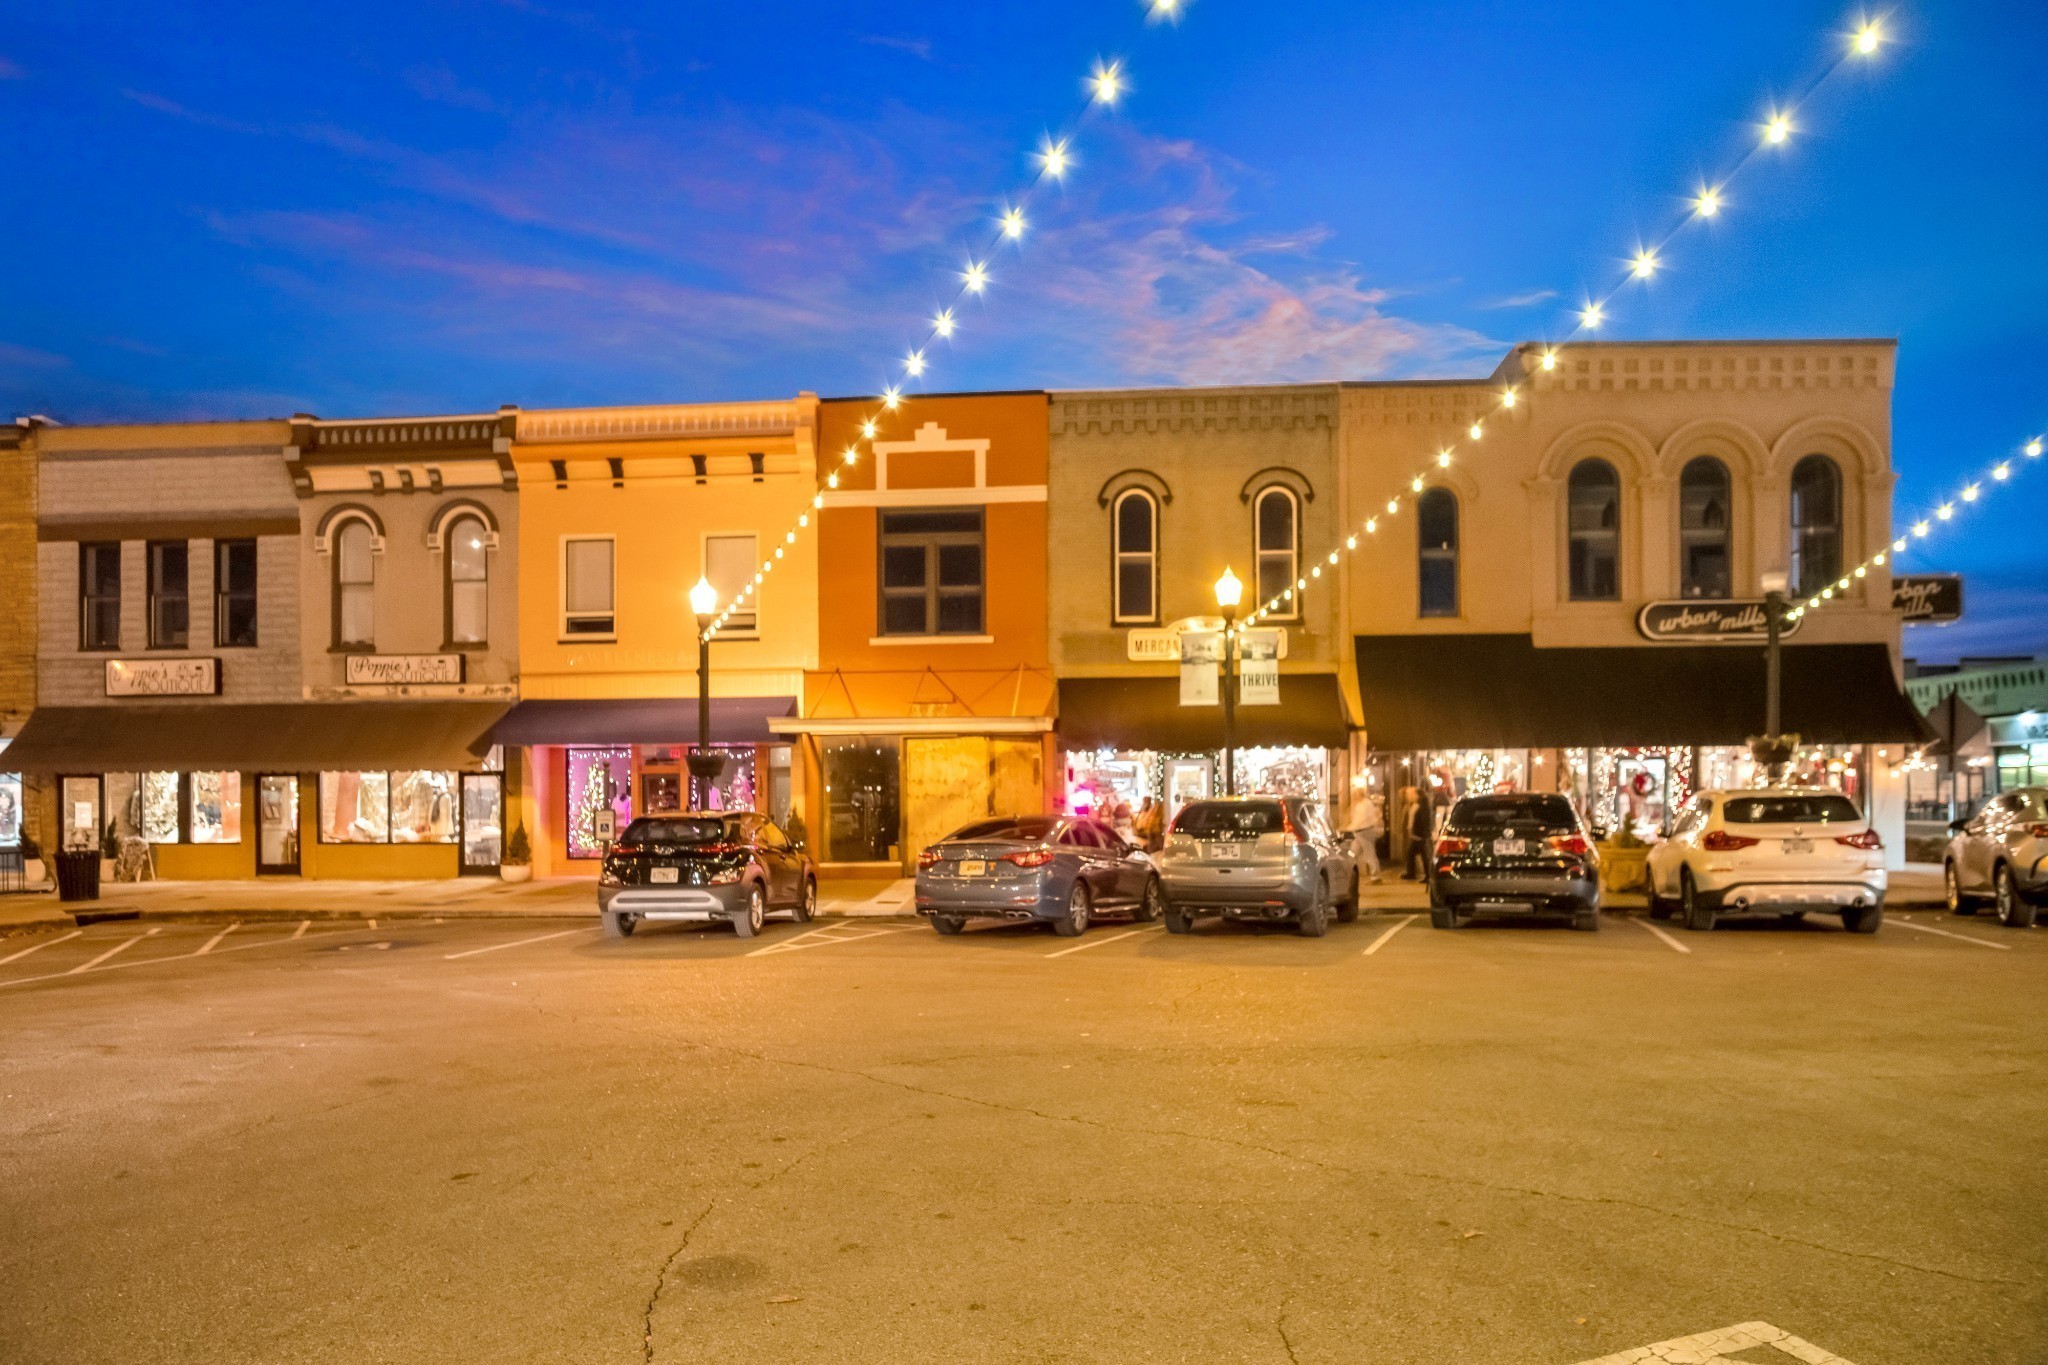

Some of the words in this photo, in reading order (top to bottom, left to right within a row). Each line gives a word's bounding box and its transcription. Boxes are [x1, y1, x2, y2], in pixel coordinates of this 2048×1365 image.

[1893, 578, 1943, 600] rban
[1901, 594, 1934, 617] ills
[1658, 606, 1722, 632] urban
[1719, 604, 1768, 631] mills
[353, 655, 412, 678] Poppie's
[384, 670, 450, 683] BOUTIQUE
[142, 679, 204, 693] BOUTIQUE
[1242, 672, 1278, 687] THRIVE
